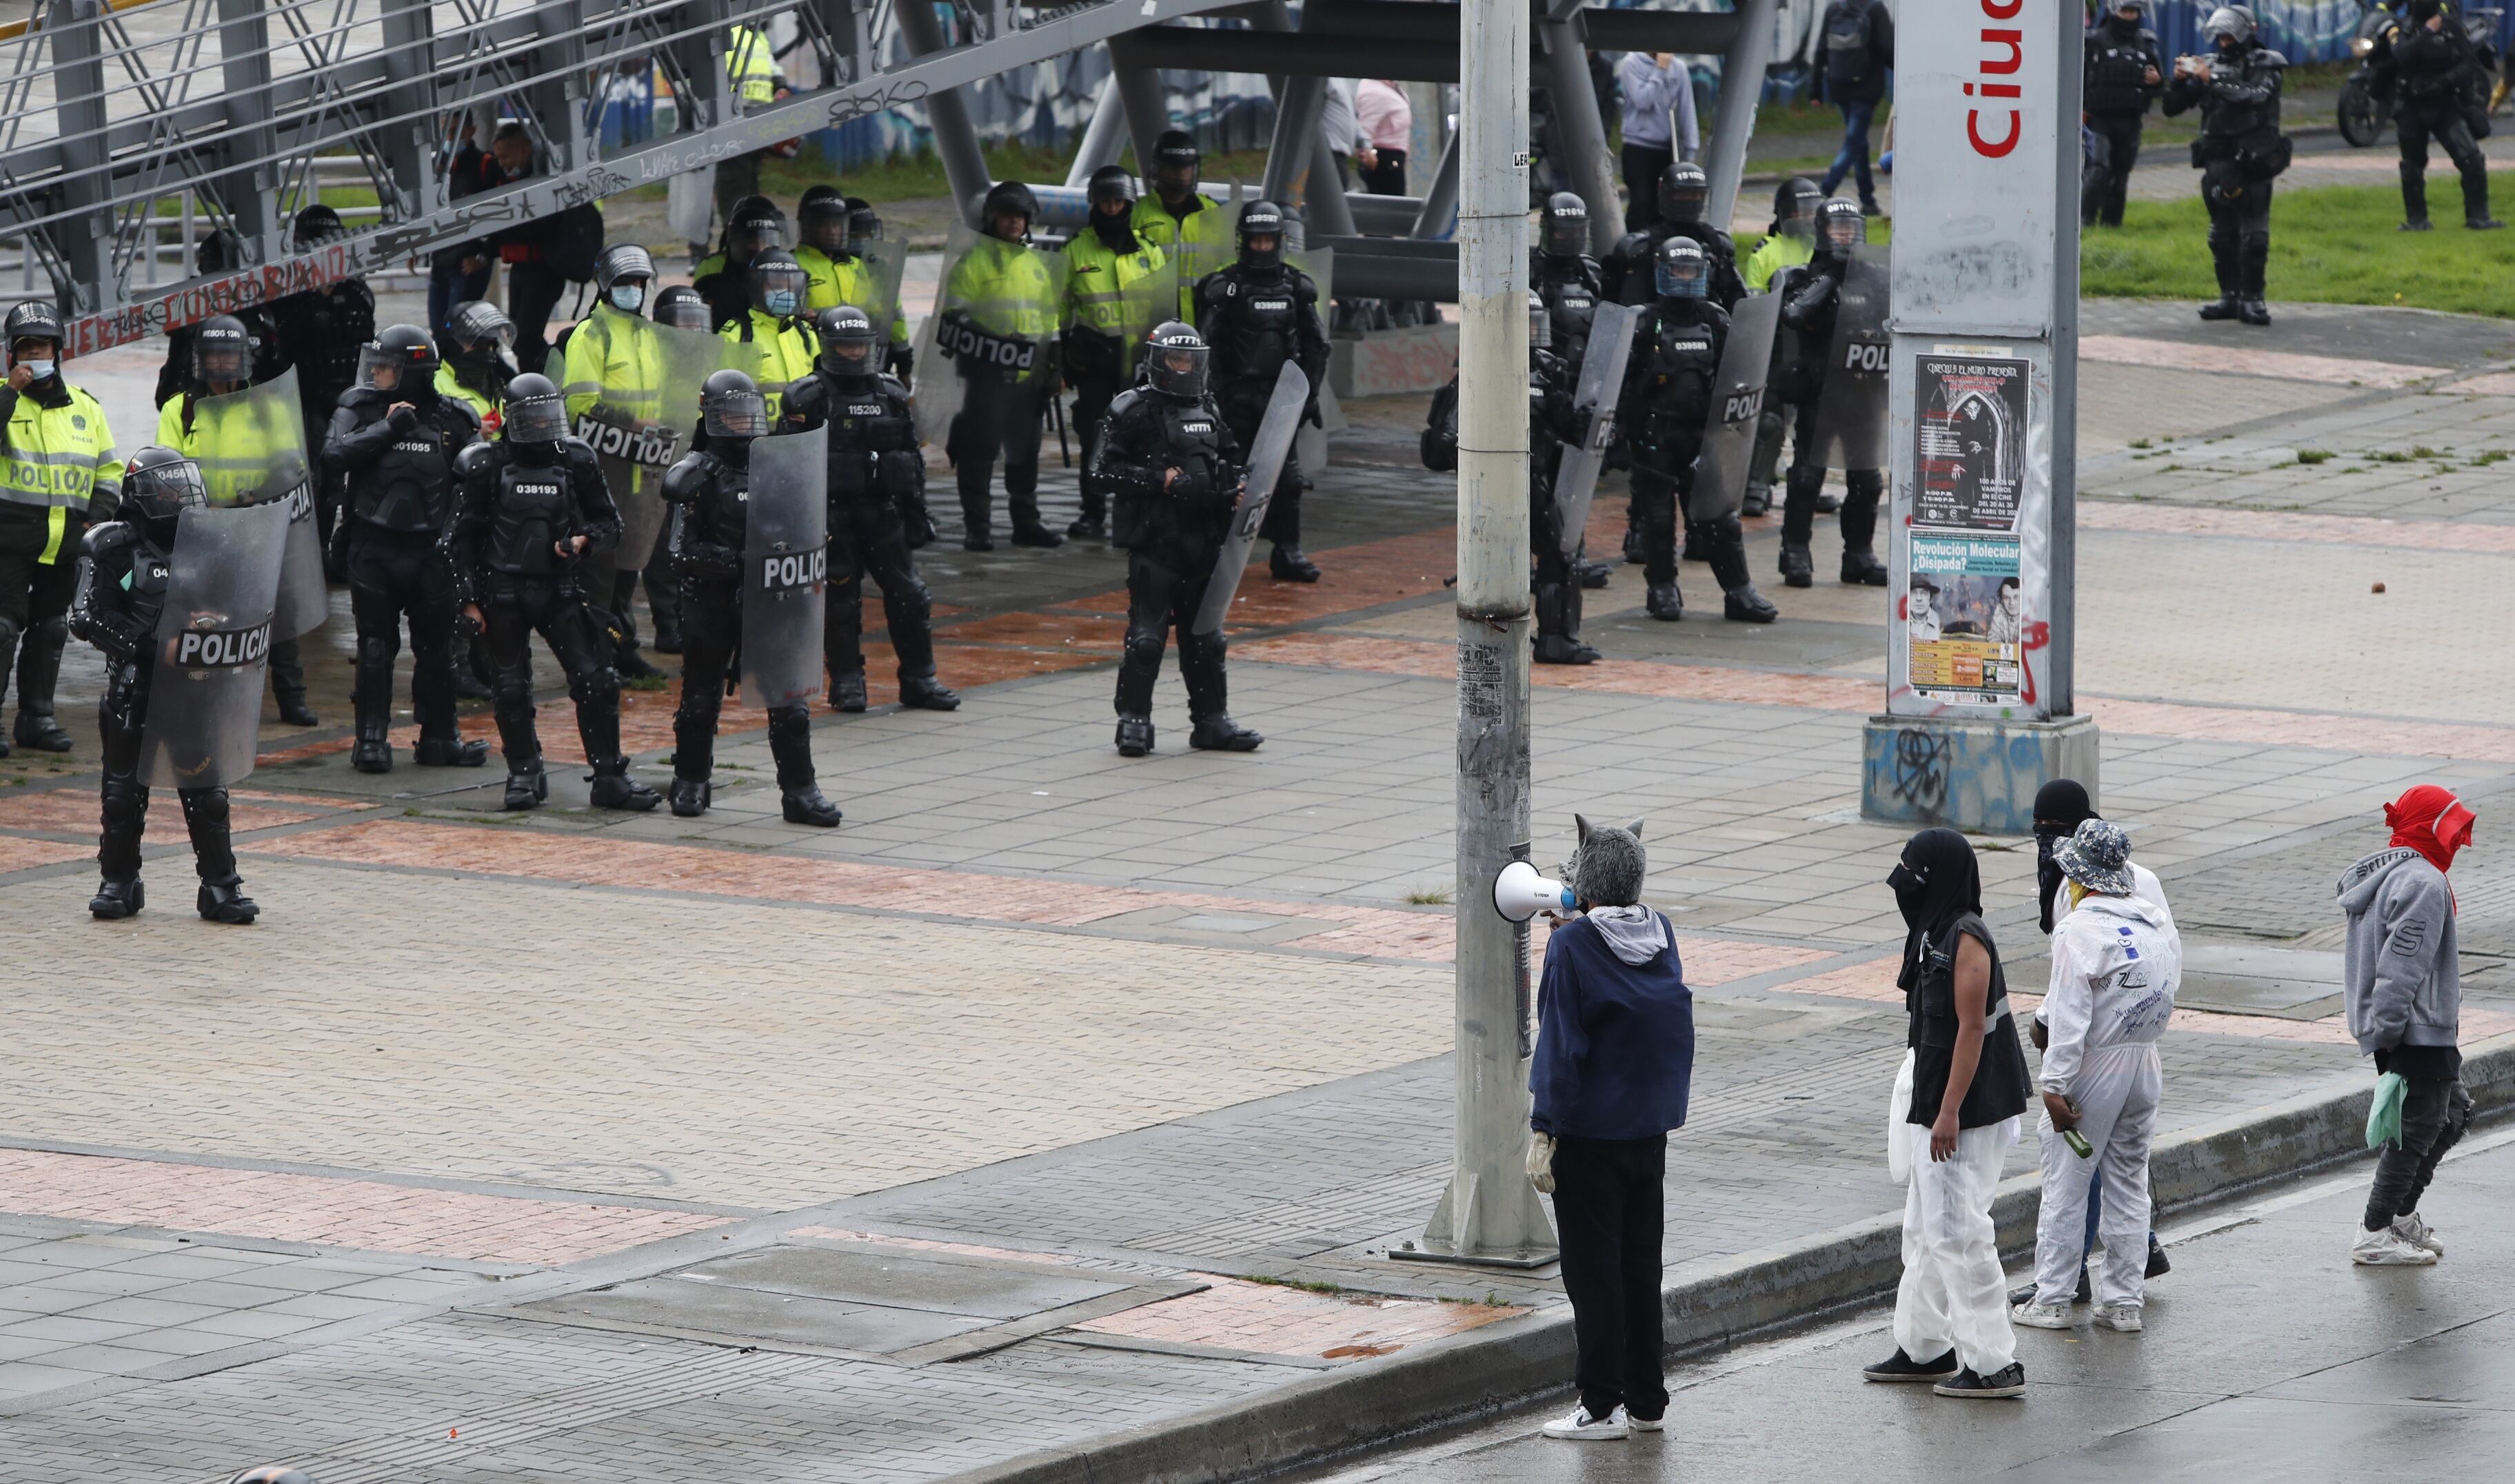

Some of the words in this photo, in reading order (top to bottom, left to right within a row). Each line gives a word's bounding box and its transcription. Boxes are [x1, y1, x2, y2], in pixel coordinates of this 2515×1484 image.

[940, 319, 1033, 368] POLICIA
[1161, 335, 1200, 346] 147771
[848, 404, 881, 415] 115200
[578, 416, 678, 466] POLICIA
[9, 463, 91, 495] POLICIA
[516, 485, 558, 495] 038193
[1912, 540, 1967, 556] Revolución
[1970, 542, 2019, 559] Molecular
[1913, 555, 1967, 573] ¿Disipada?
[179, 626, 270, 664] POLICIA
